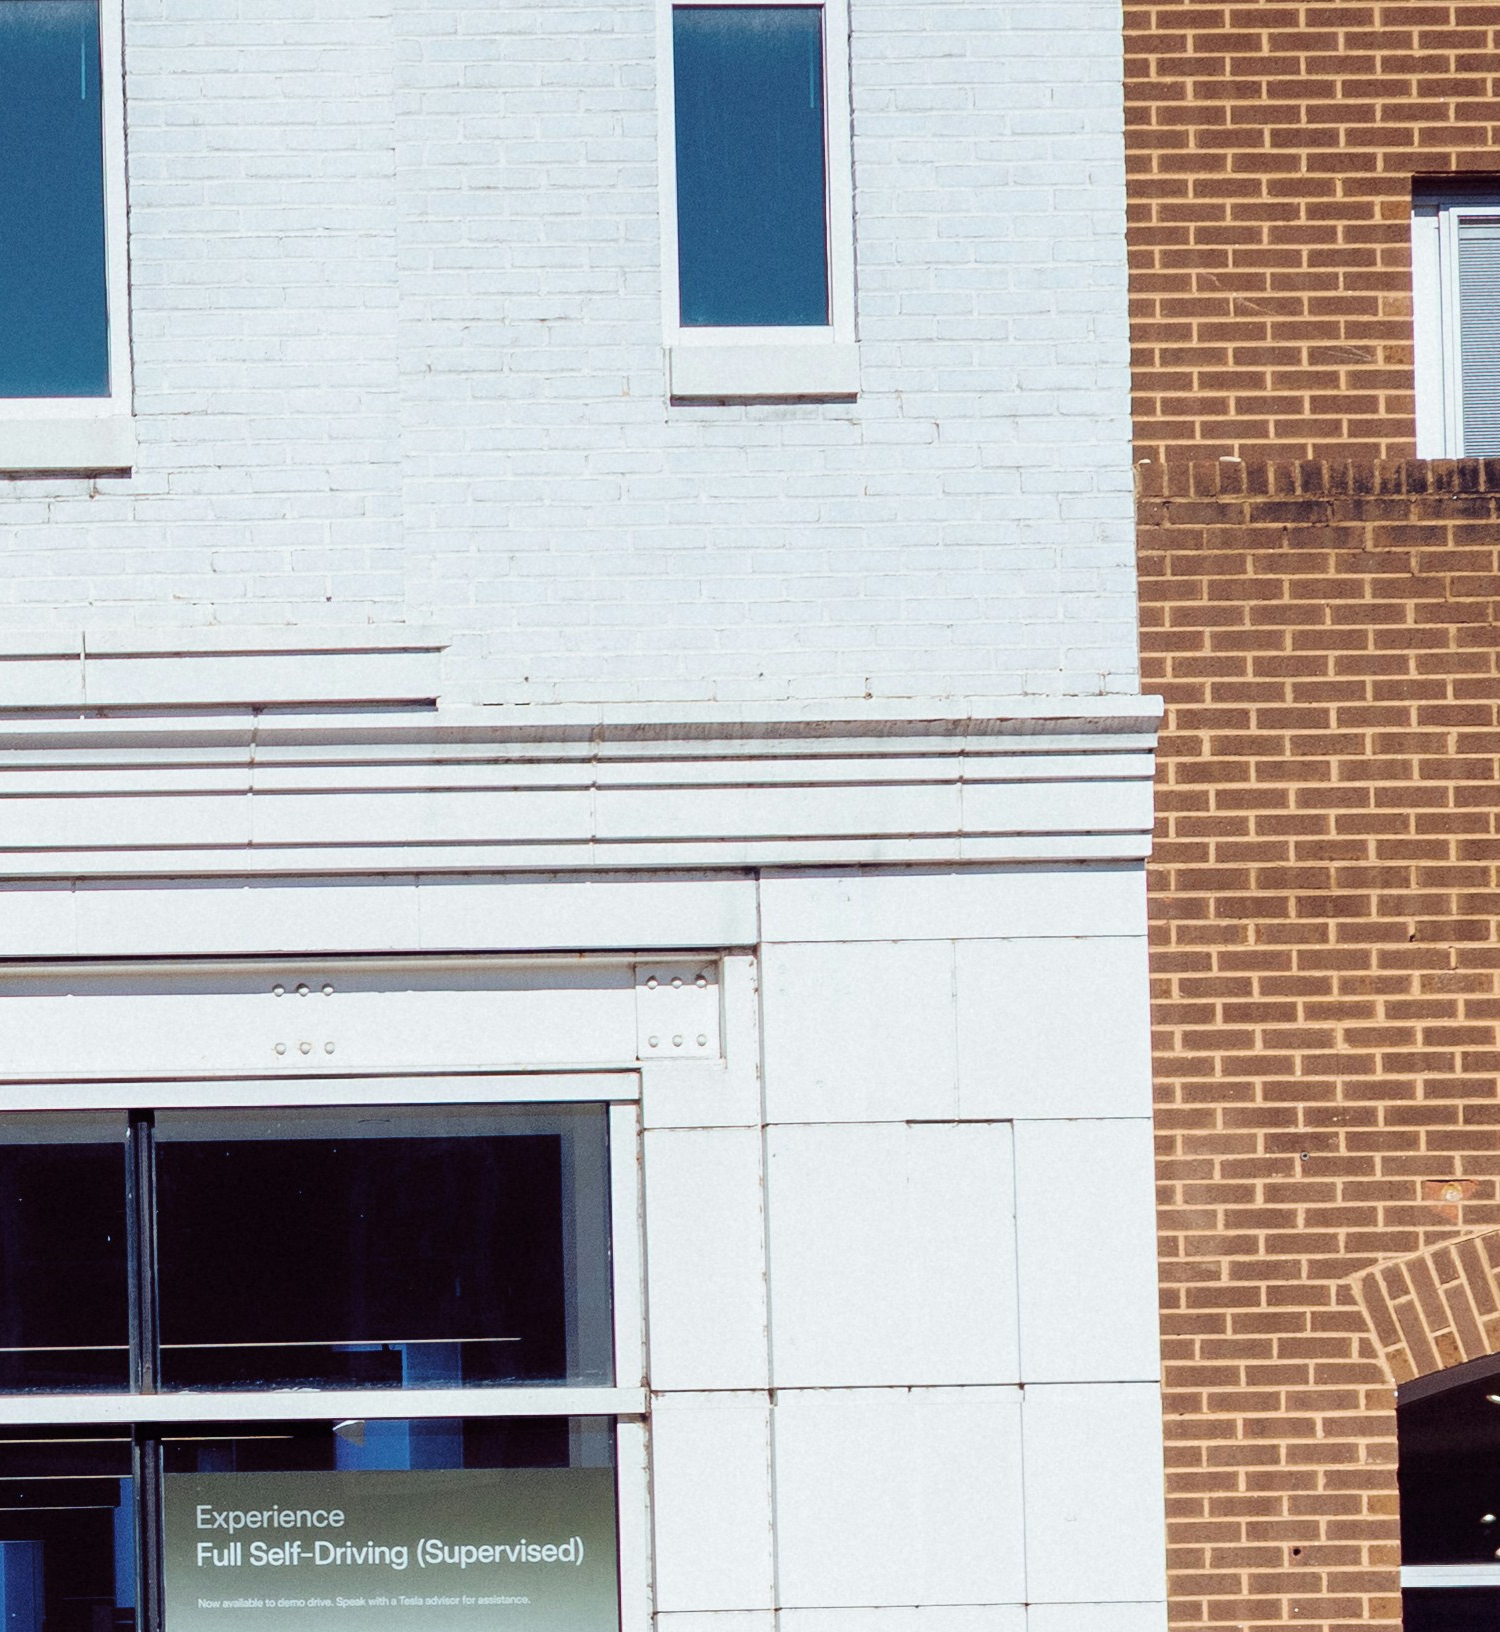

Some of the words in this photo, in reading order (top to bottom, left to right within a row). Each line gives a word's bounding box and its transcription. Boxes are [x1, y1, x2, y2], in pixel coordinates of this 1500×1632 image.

[196, 1504, 345, 1534] Experience
[197, 1541, 242, 1567] Full
[249, 1541, 408, 1570] Self-Driving
[416, 1536, 585, 1569] (Supervised)
[198, 1598, 220, 1608] Now
